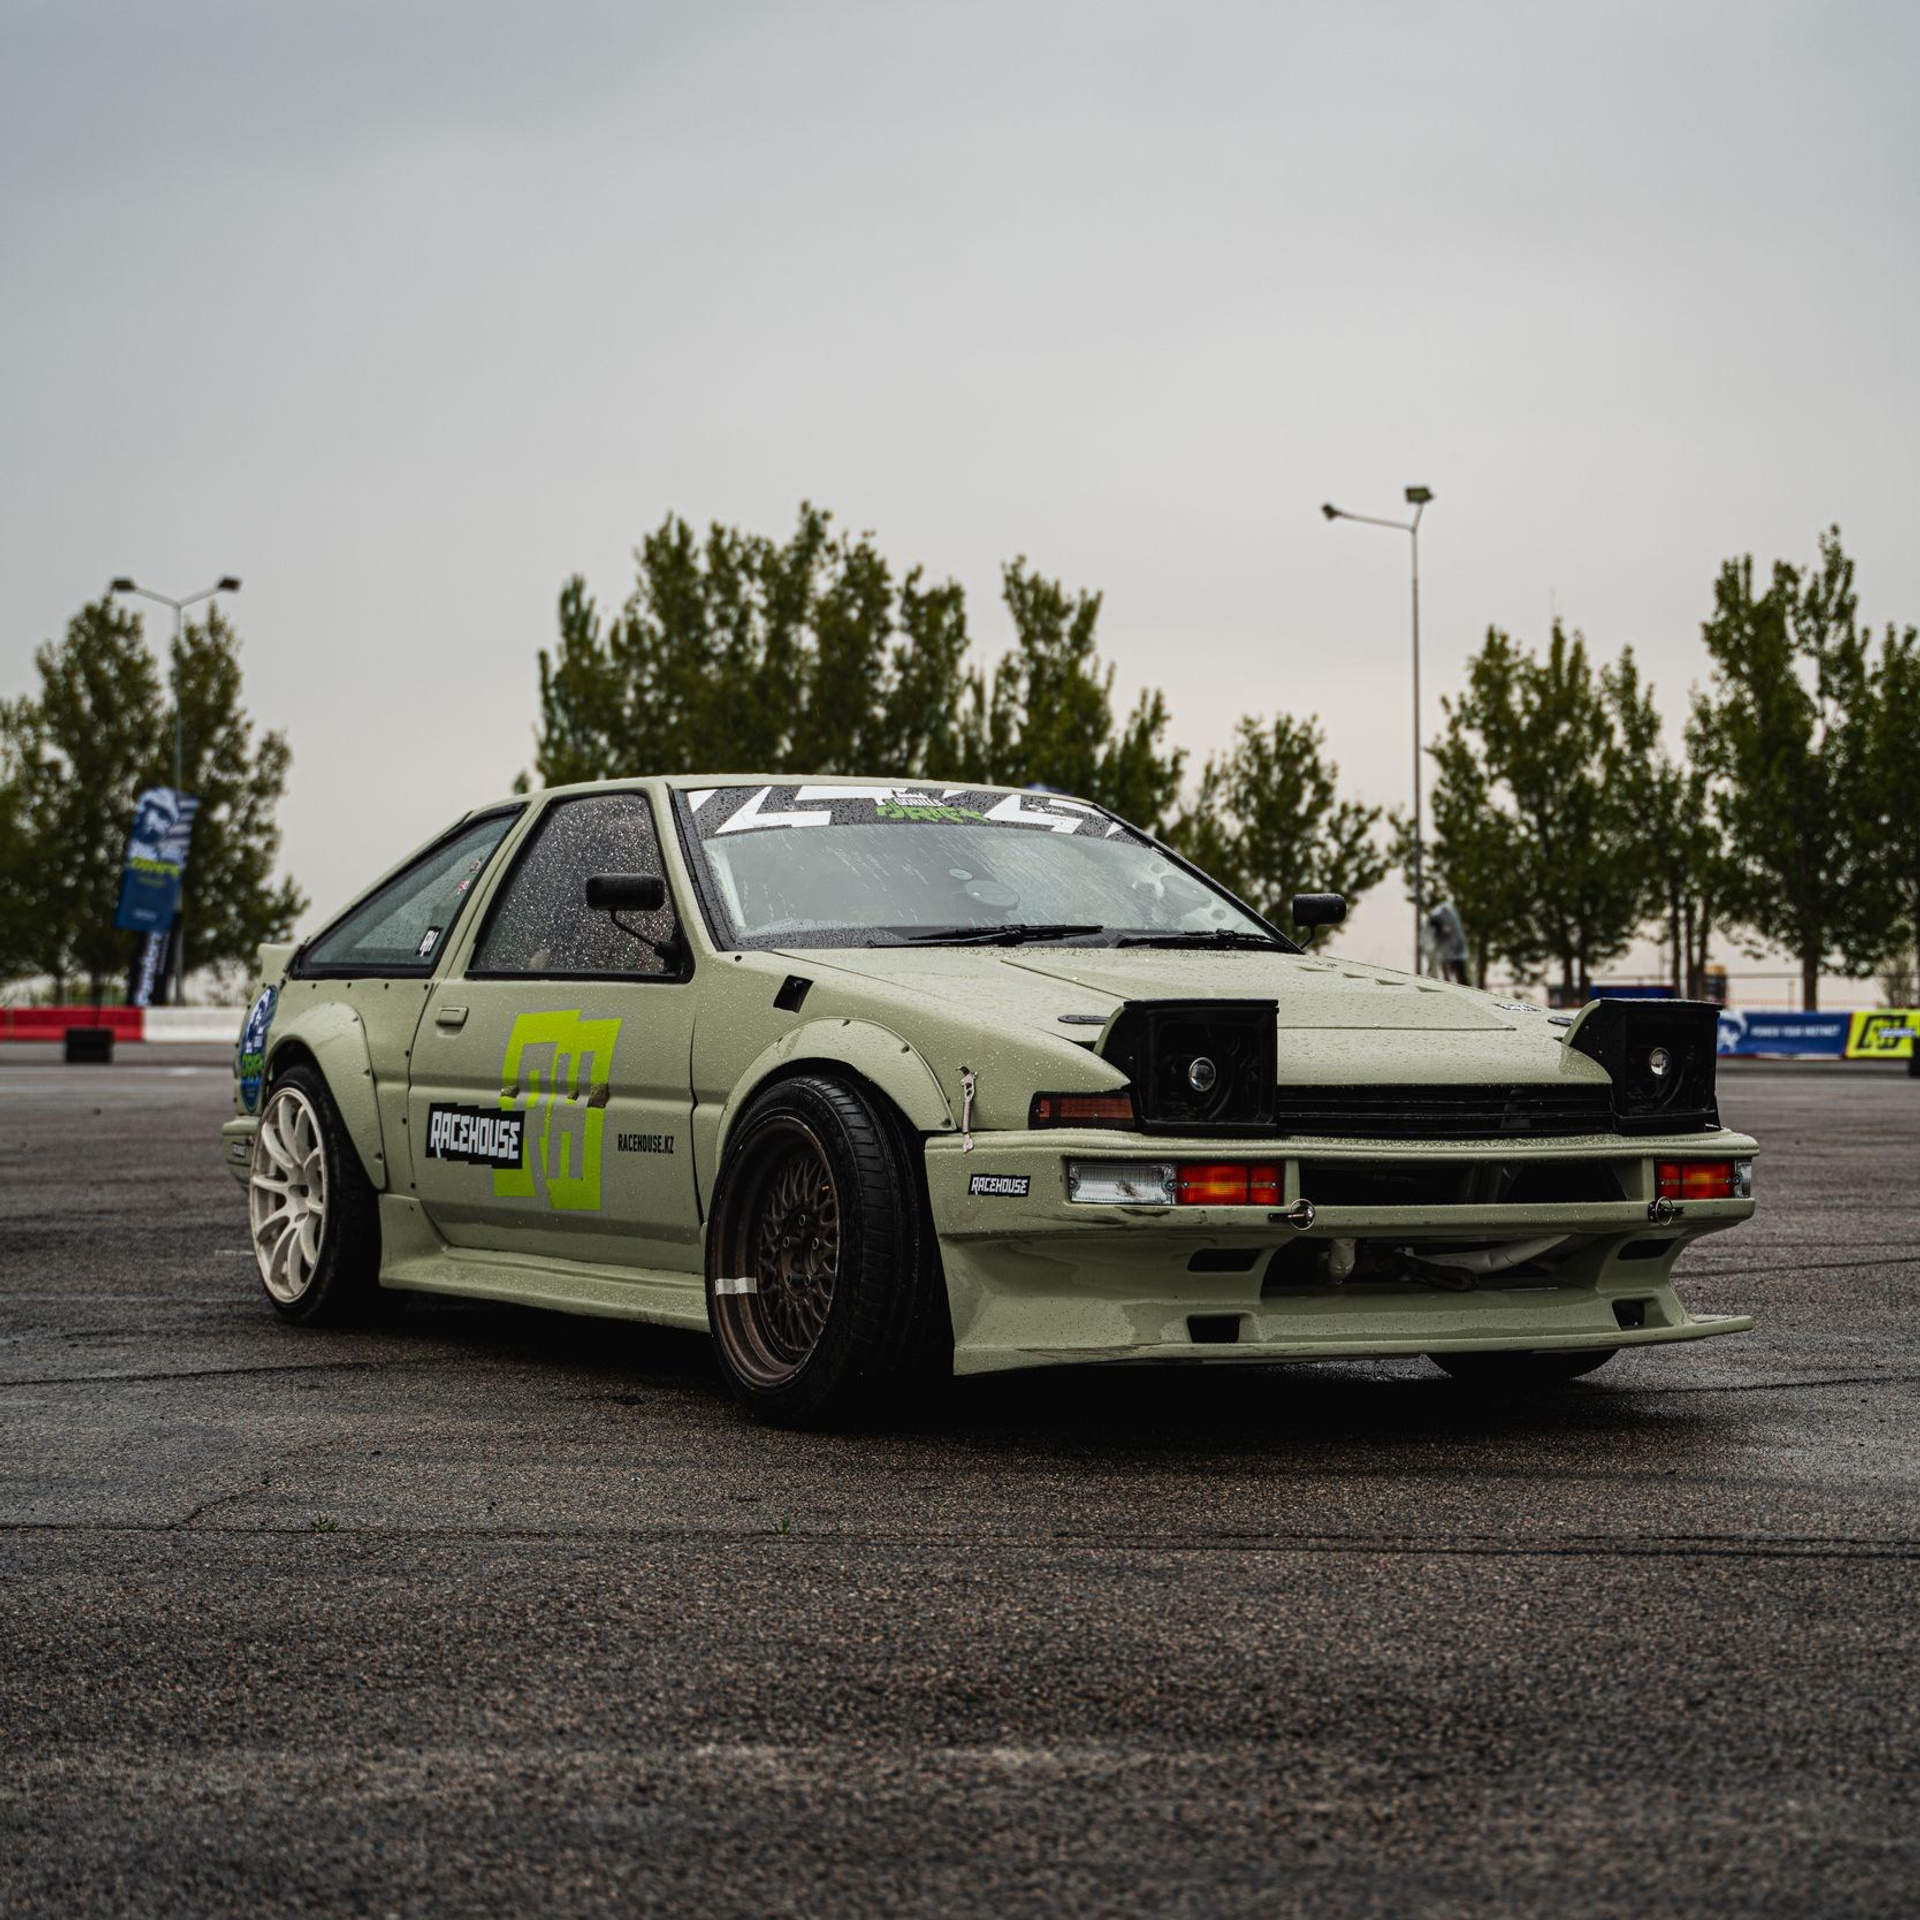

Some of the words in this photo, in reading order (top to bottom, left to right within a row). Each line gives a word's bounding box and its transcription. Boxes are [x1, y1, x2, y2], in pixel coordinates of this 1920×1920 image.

[430, 1111, 520, 1159] RACEHOUSE
[618, 1133, 675, 1154] RACEHOUSE.KZ
[971, 1176, 1028, 1195] RACEHOUSE
